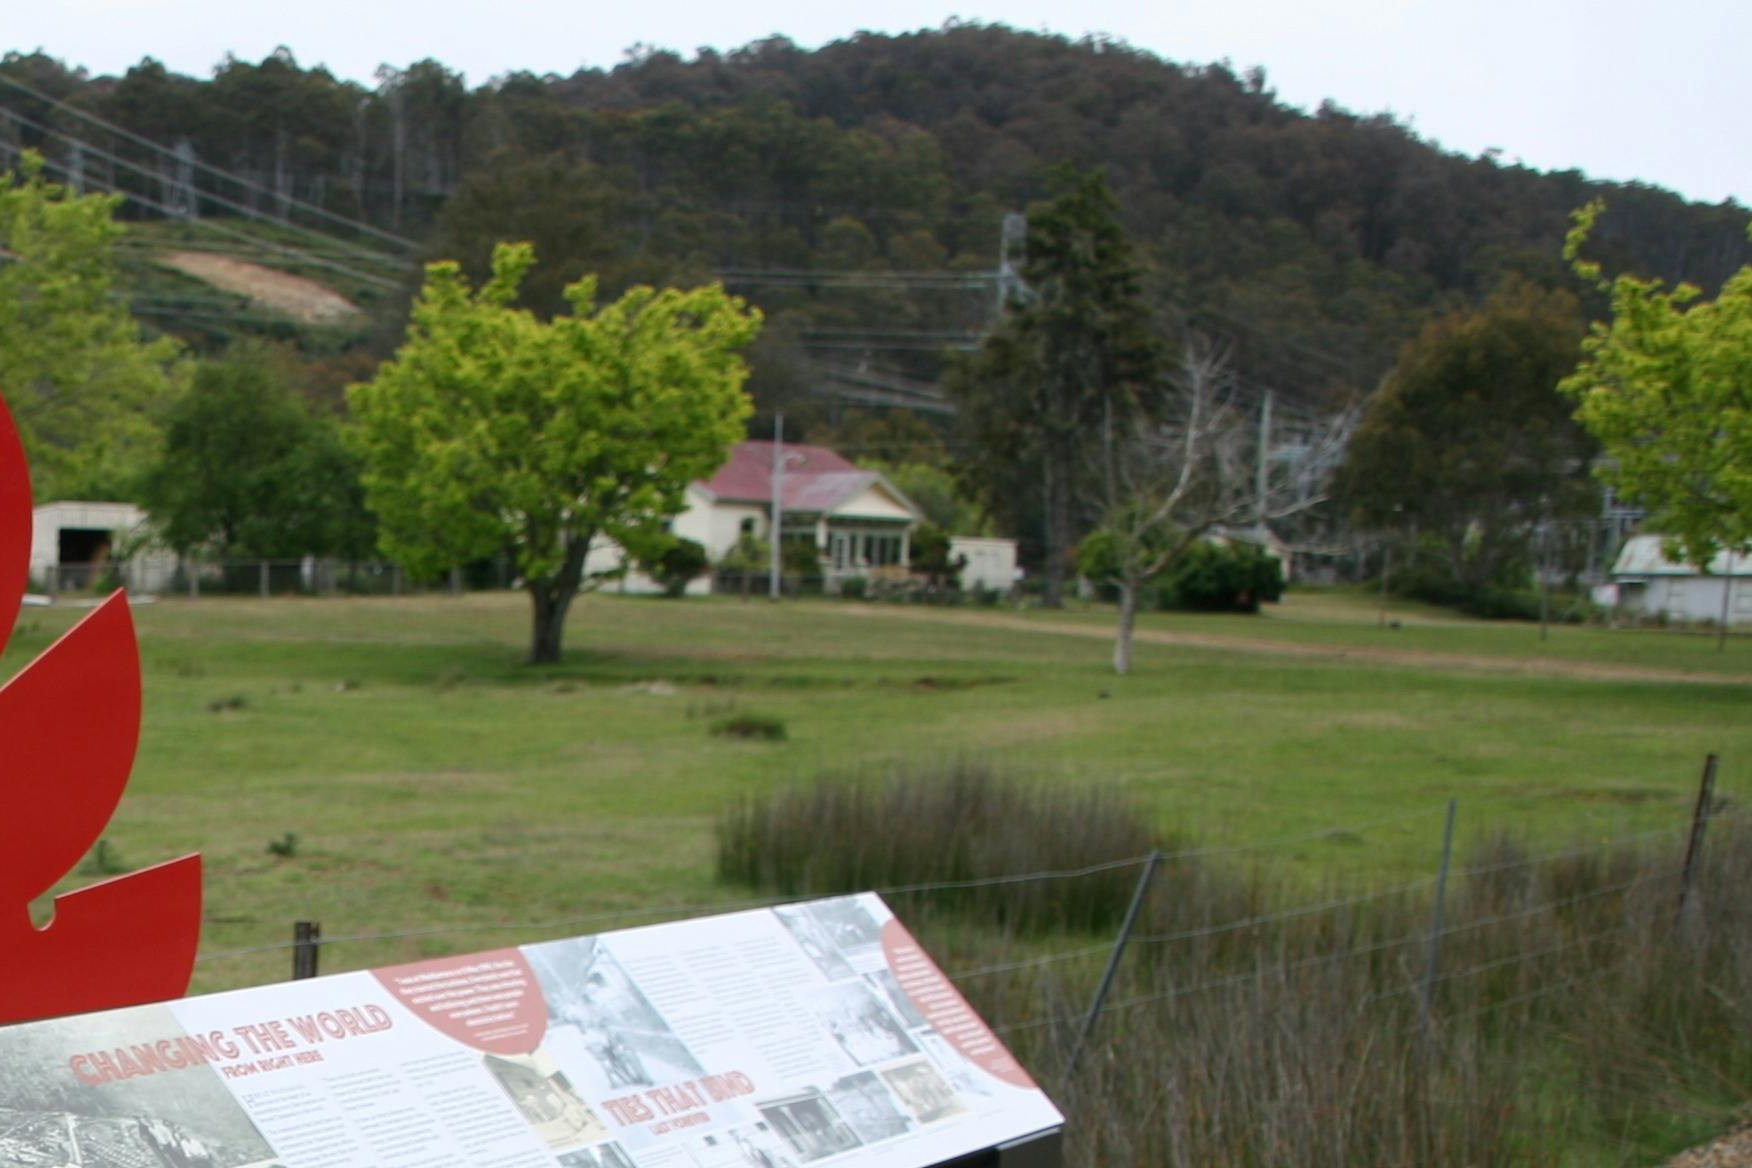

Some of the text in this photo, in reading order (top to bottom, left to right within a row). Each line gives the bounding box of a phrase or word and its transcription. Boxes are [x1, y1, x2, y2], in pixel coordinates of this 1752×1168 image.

[69, 1004, 393, 1088] CHANGING THE WORLD
[221, 1049, 325, 1080] FROM RIGHT HERE
[601, 1094, 655, 1126] TIES
[645, 1080, 707, 1115] THAT
